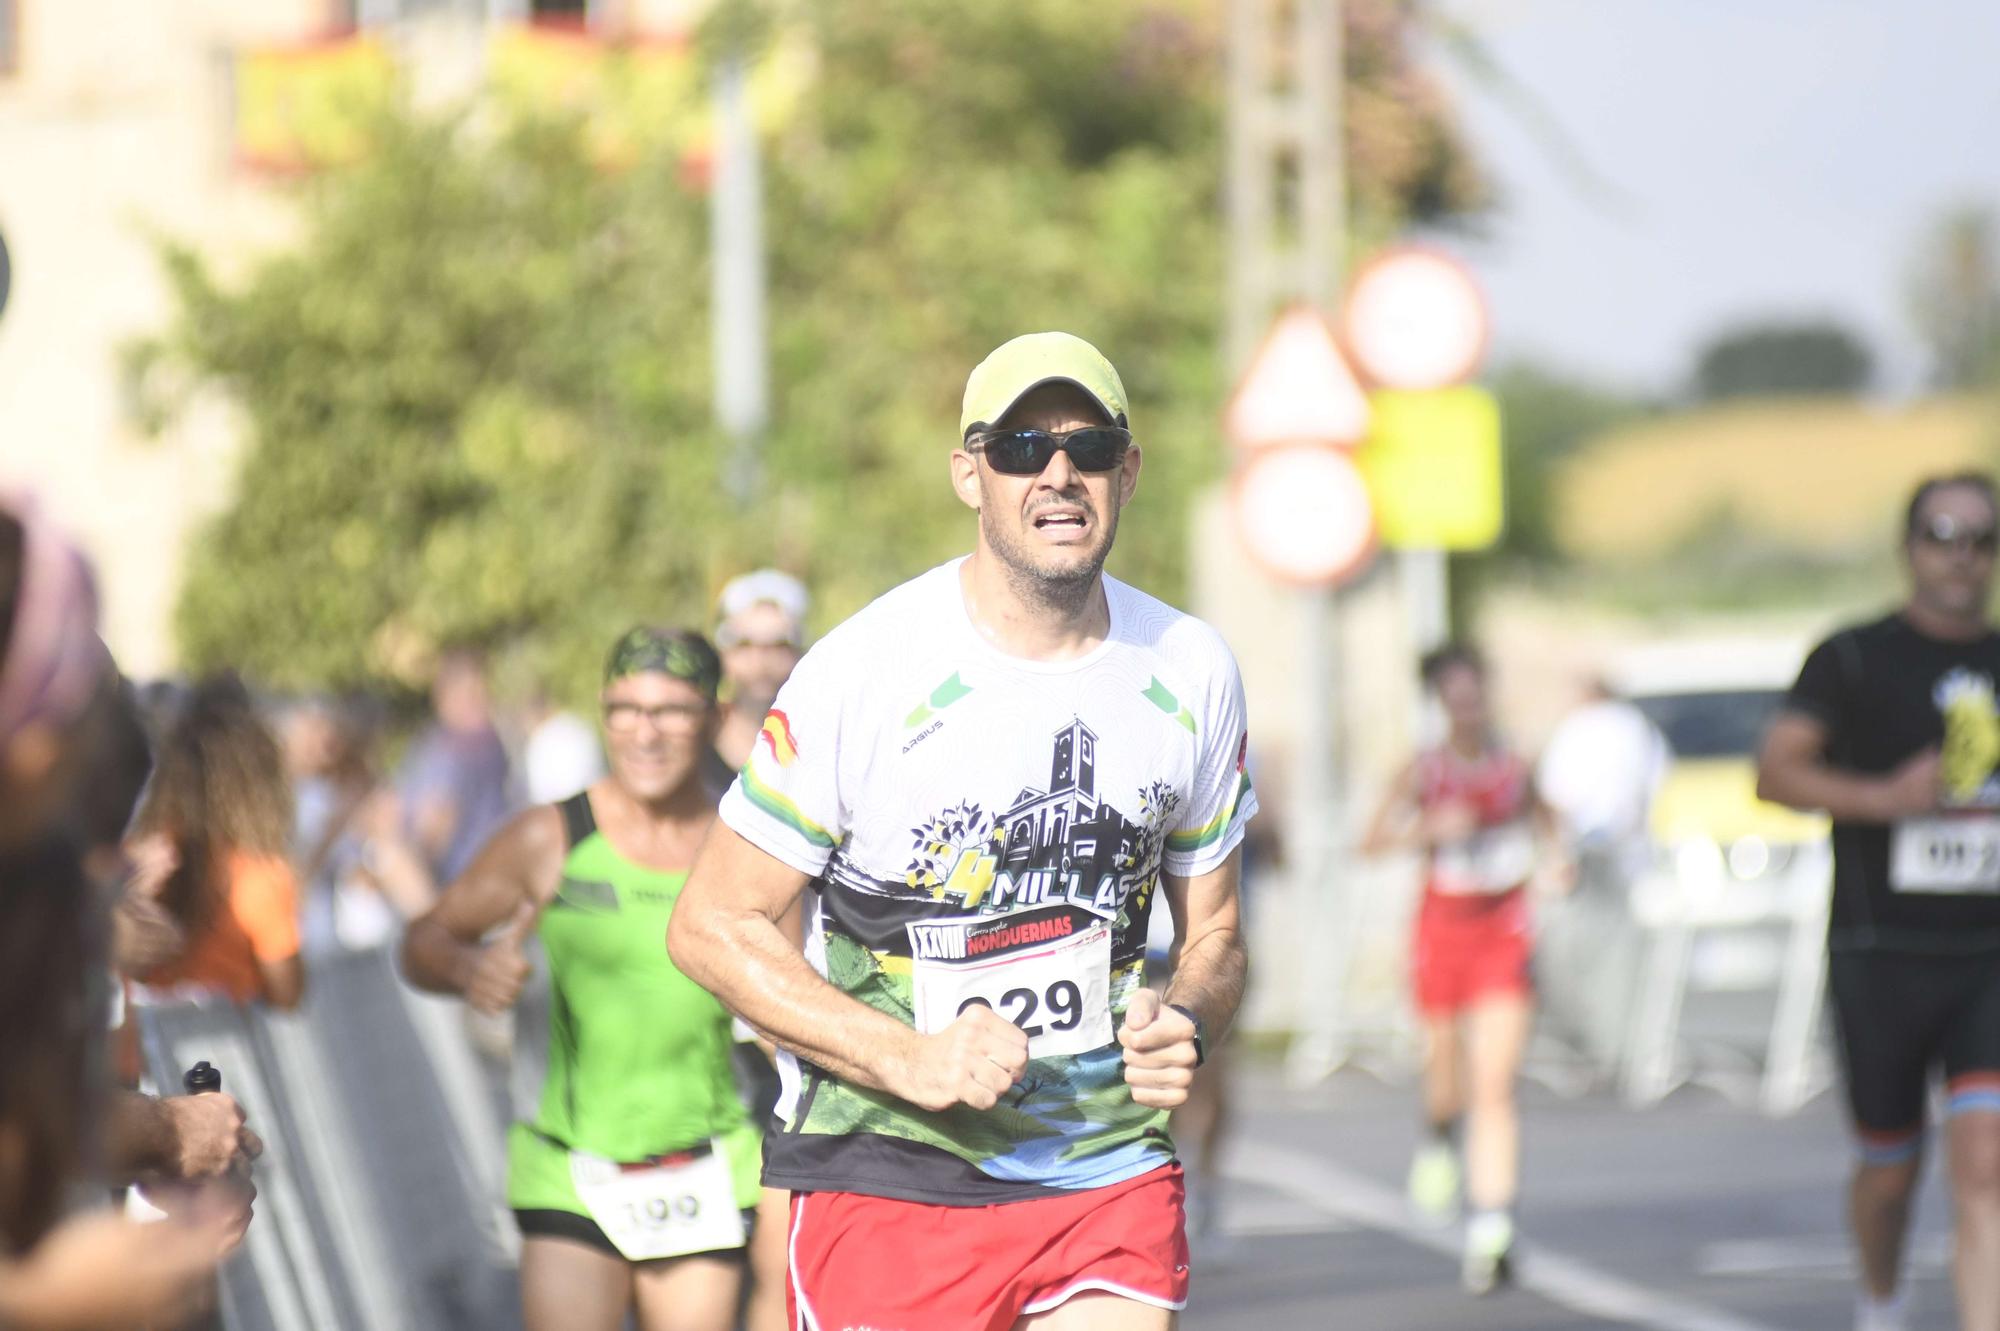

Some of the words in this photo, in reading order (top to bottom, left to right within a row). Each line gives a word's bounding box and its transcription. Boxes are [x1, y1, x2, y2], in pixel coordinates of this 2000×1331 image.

[902, 720, 944, 754] ARGIUS
[945, 848, 998, 909] 4
[991, 870, 1134, 909] MILLAS
[915, 925, 967, 960] XXVIII
[967, 916, 1072, 955] NONDUERMAS
[956, 979, 1083, 1038] 29
